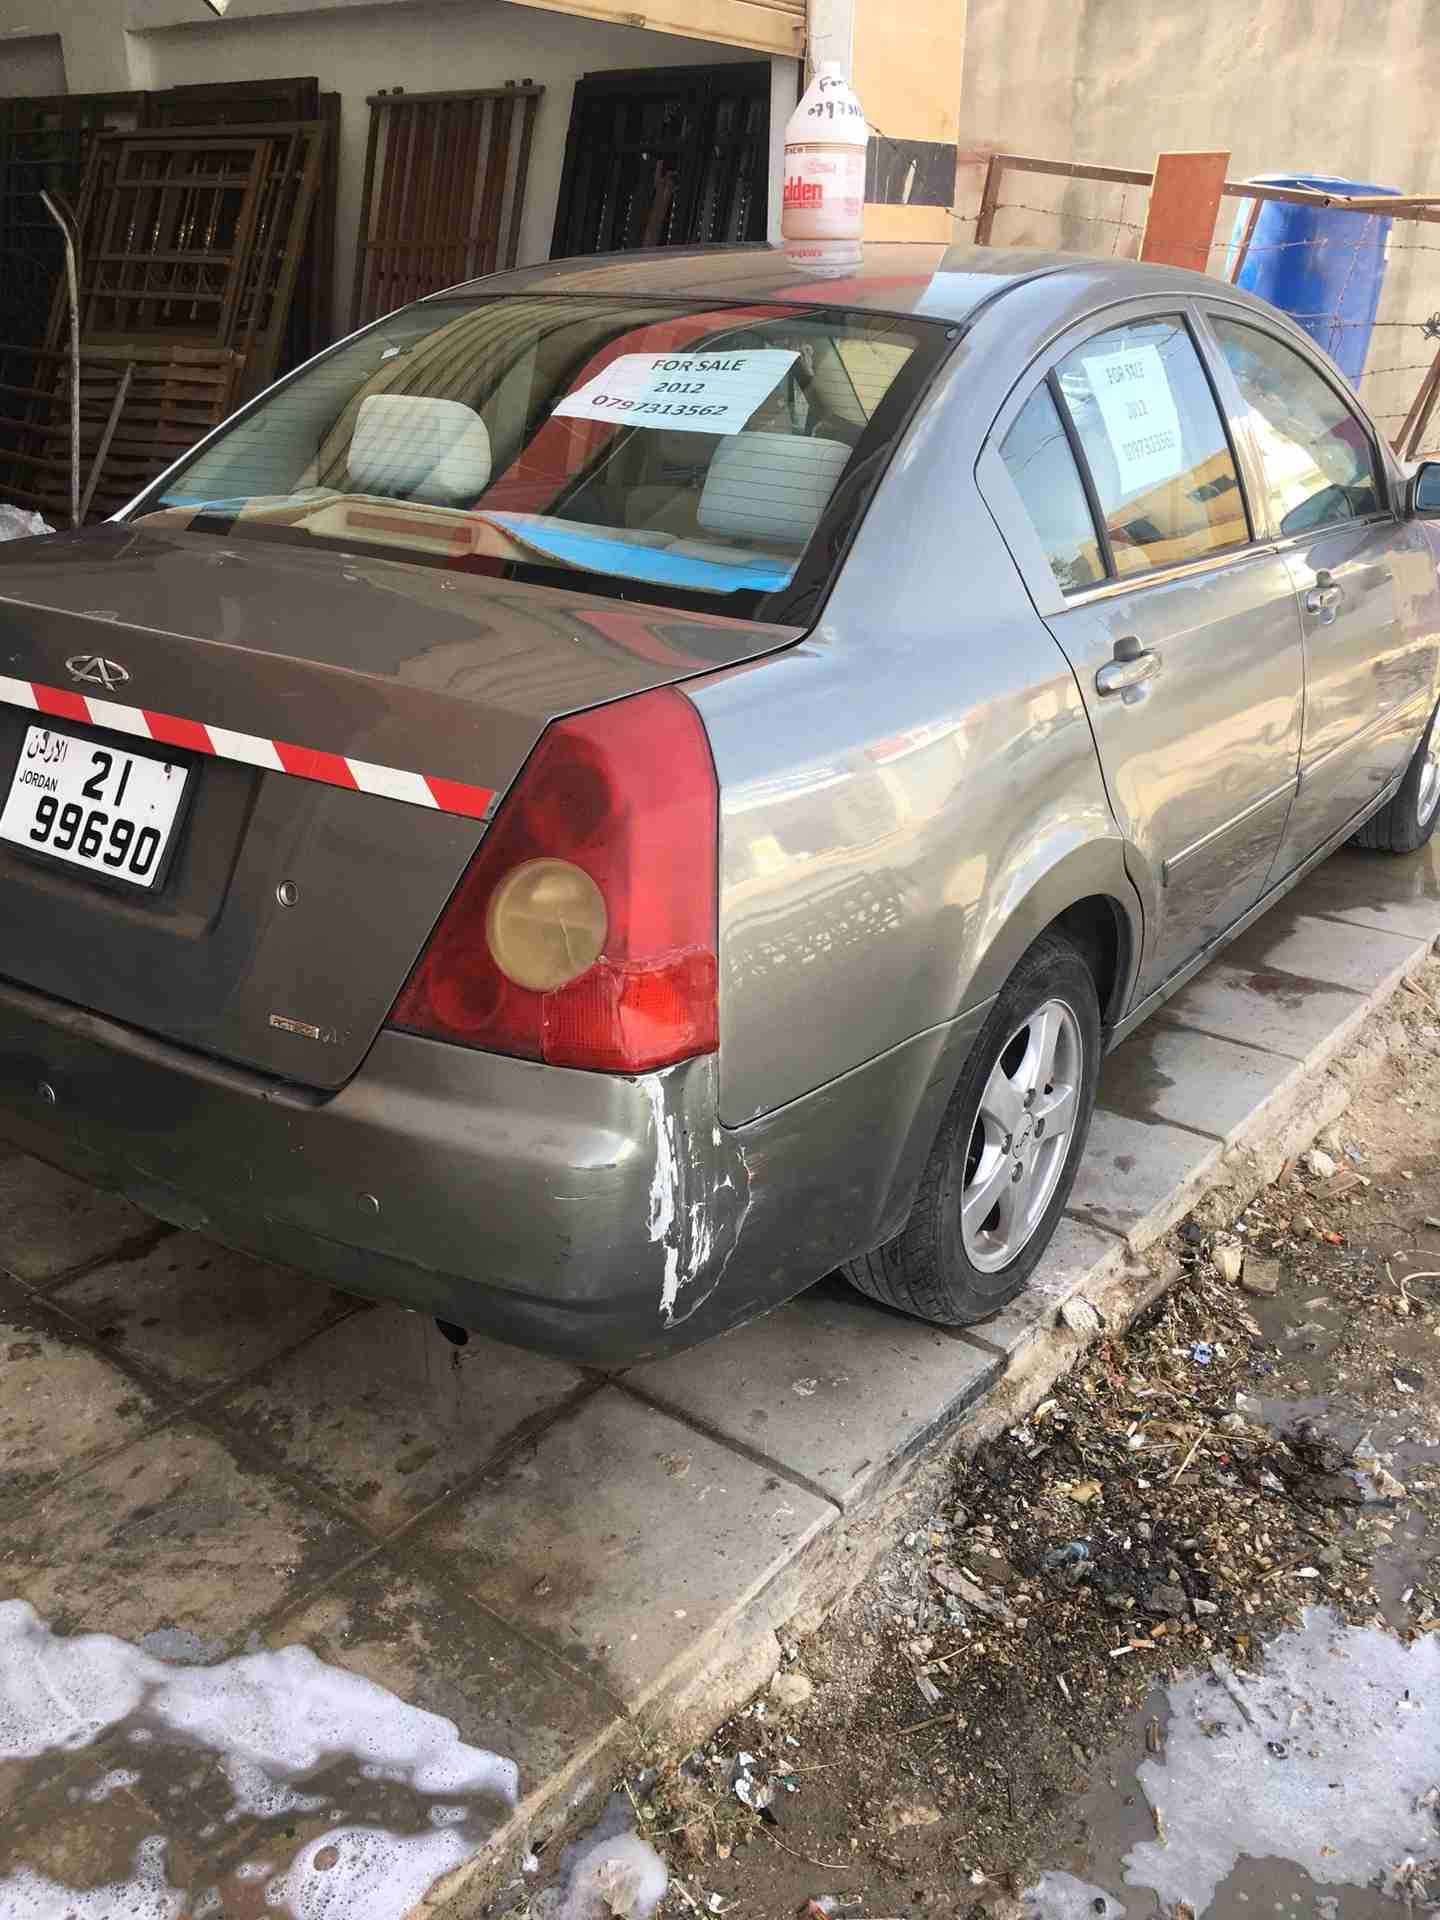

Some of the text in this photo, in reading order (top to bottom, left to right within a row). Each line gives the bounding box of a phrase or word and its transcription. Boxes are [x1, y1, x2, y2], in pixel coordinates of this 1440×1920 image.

[651, 358, 747, 372] FOR SALE
[653, 382, 706, 394] 2012
[591, 395, 729, 417] 0797313562
[18, 769, 58, 793] JORDAN
[81, 750, 133, 807] 21
[29, 795, 161, 876] 99690
